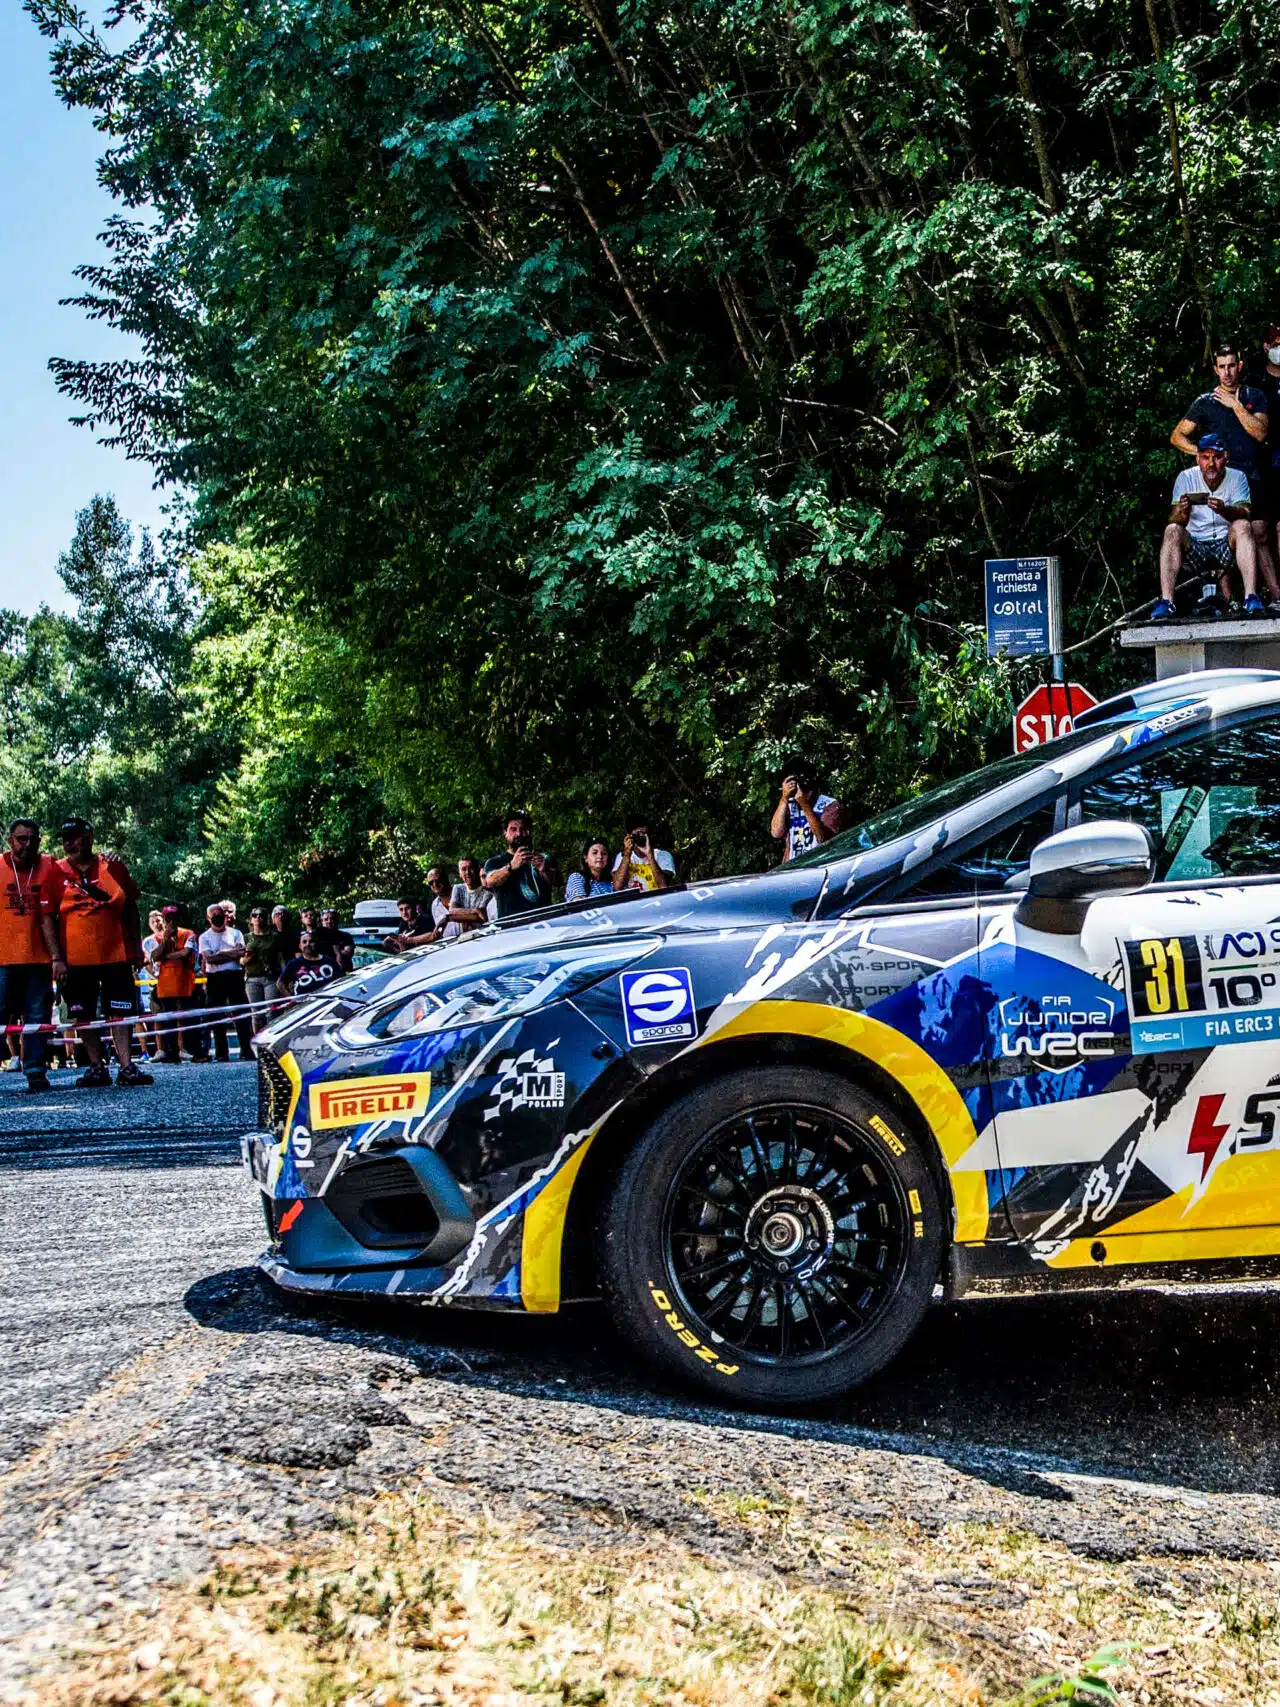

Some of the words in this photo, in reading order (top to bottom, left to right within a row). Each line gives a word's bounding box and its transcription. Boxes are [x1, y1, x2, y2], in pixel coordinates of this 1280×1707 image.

[992, 572, 1033, 582] Fermata
[1034, 571, 1041, 580] a
[996, 582, 1038, 594] richiesta
[993, 599, 1043, 616] cotral
[1020, 714, 1074, 749] STO
[1140, 937, 1190, 1014] 31
[1042, 995, 1072, 1006] FIA
[1007, 1011, 1107, 1026] JUNIOR
[1205, 1021, 1231, 1037] FIA
[1235, 1014, 1274, 1033] ERC3
[641, 1024, 684, 1038] sparco
[1001, 1031, 1115, 1056] WRC
[526, 1075, 552, 1097] M
[556, 1074, 564, 1098] SPORT
[319, 1082, 417, 1120] PIRELLI
[528, 1100, 564, 1109] POLAND
